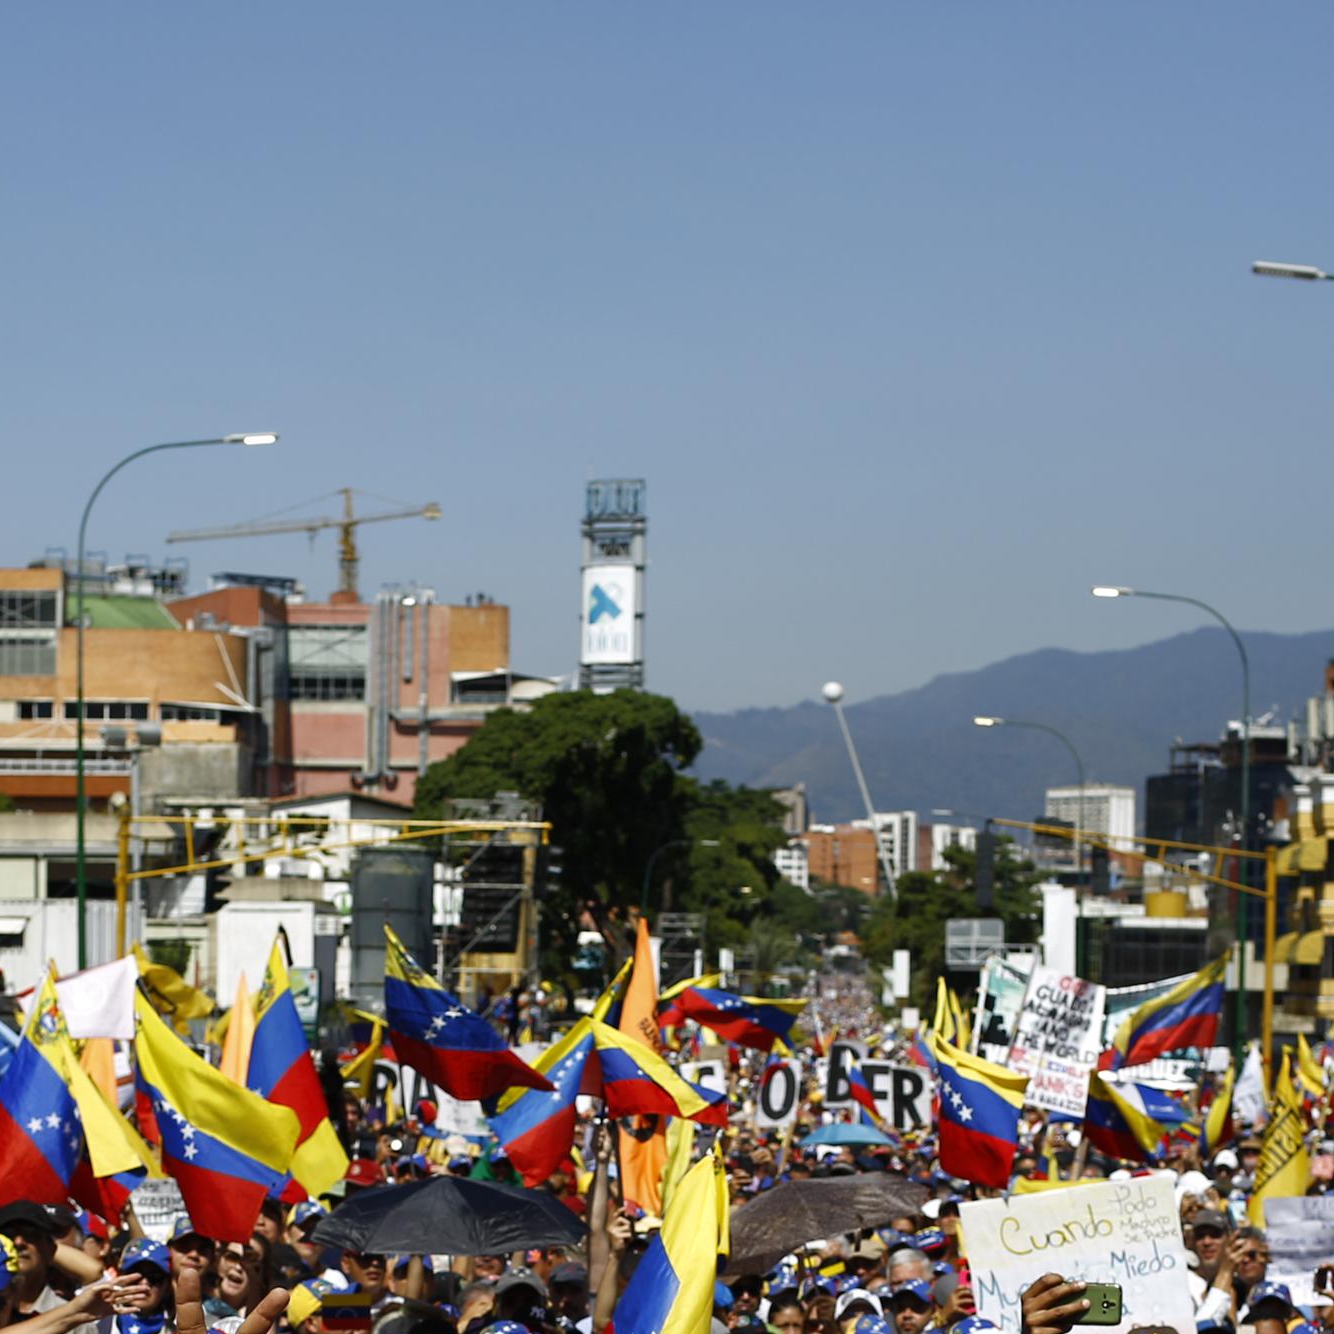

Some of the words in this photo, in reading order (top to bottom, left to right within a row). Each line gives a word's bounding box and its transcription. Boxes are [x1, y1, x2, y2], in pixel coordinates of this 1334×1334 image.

[1043, 1041, 1096, 1063] WORLD
[1000, 1203, 1113, 1255] Cuando
[1111, 1238, 1176, 1280] Miedo
